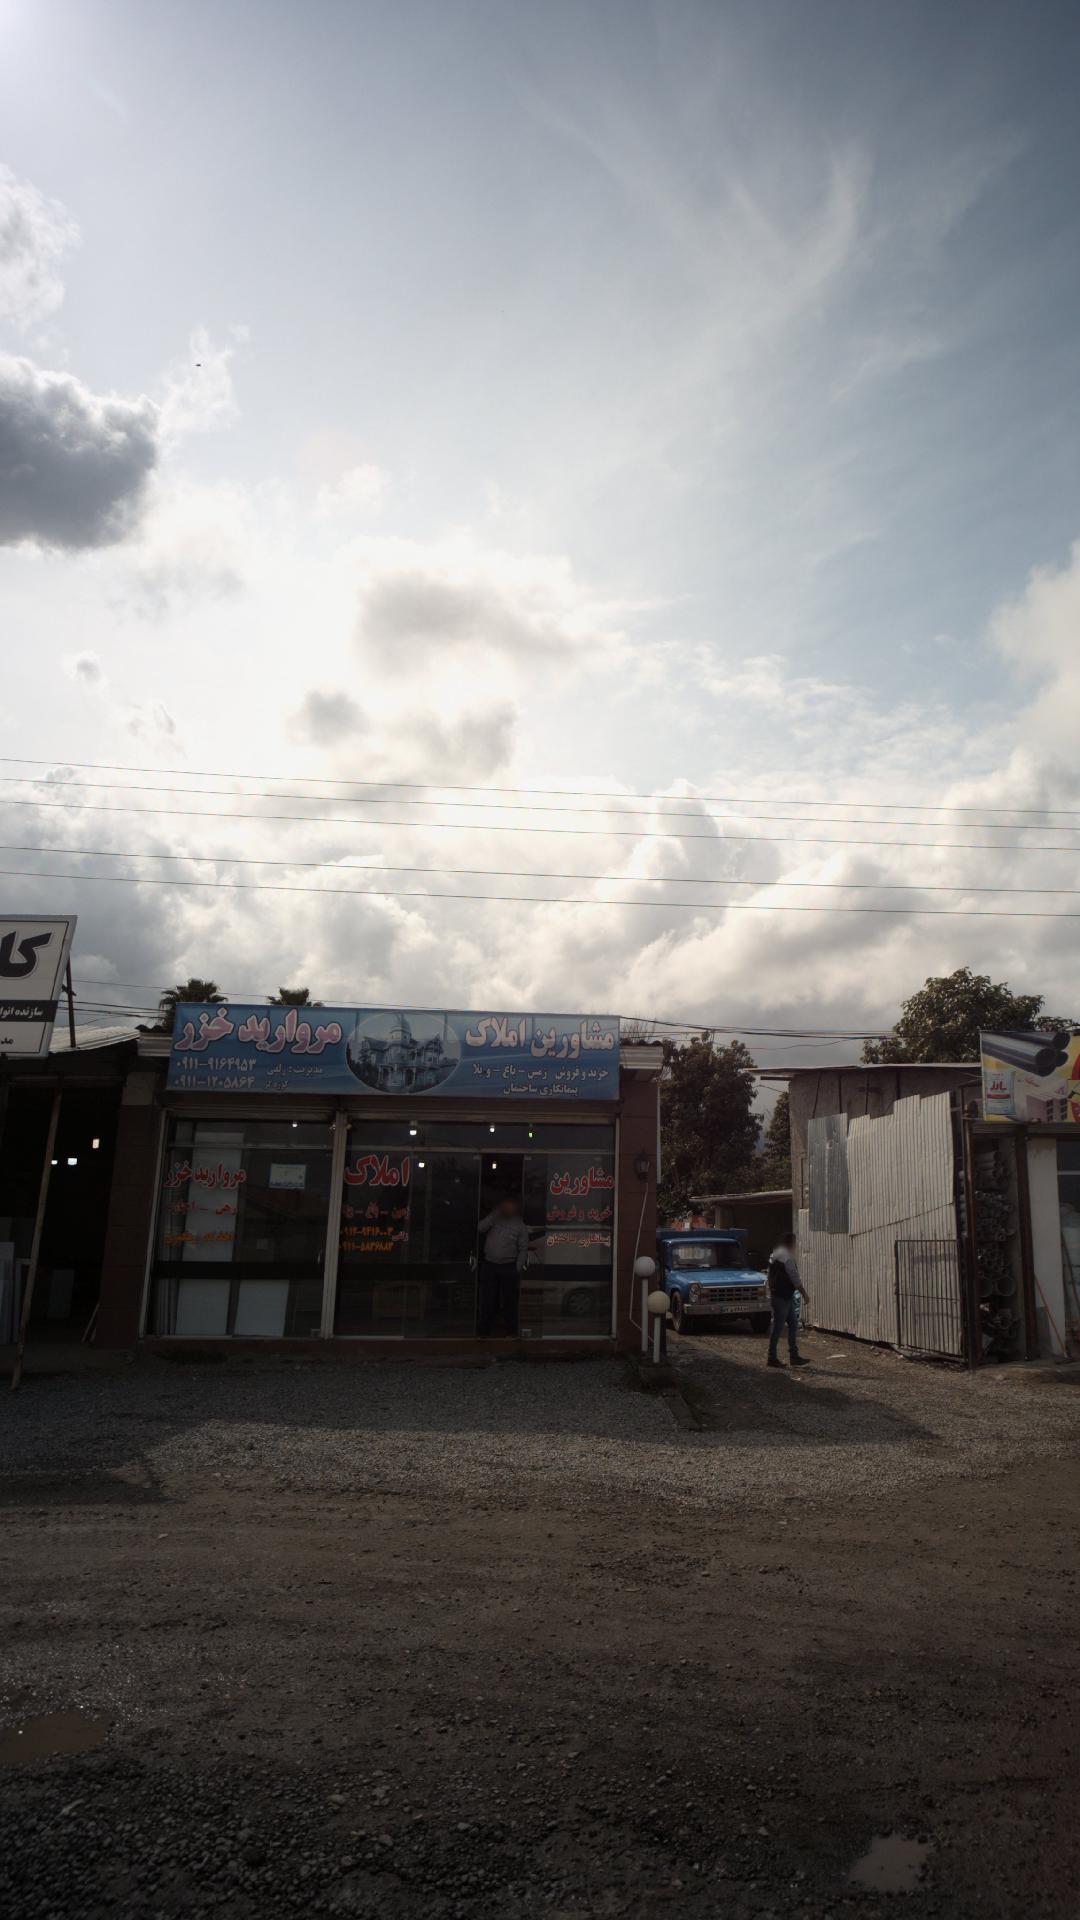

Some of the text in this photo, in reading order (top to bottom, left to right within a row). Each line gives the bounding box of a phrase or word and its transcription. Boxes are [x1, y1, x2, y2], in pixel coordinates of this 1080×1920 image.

[15, 1006, 44, 1018] سازنده
[174, 1007, 342, 1054] مروارید خزر
[466, 1016, 615, 1059] مشاورین املاک
[503, 1065, 516, 1078] باغ
[528, 1067, 547, 1080] زمین
[555, 1065, 580, 1080] فروش
[588, 1067, 609, 1080] خرید
[504, 1083, 578, 1096] پیمانکاری ساختمان
[165, 1160, 247, 1189] مروارید خزر
[344, 1154, 410, 1187] املاک
[550, 1166, 615, 1195] مشاورین
